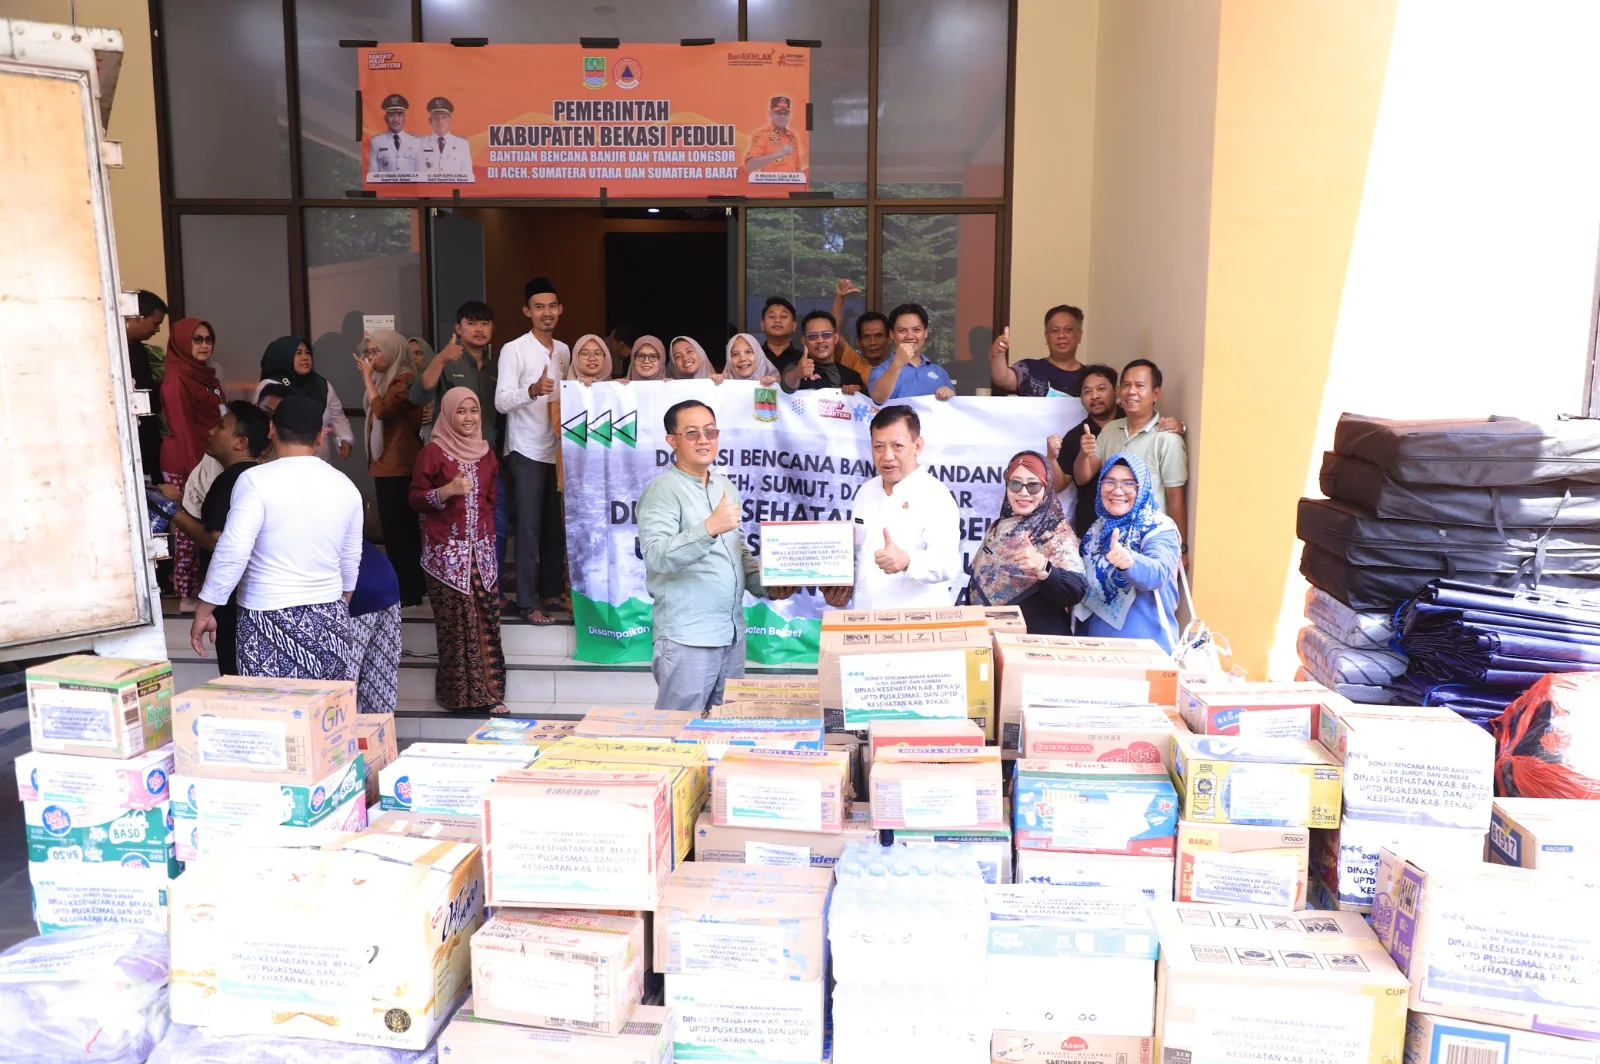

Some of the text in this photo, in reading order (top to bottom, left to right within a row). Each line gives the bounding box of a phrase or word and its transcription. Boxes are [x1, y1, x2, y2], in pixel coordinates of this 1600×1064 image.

[553, 100, 670, 121] PEMERINTAH
[488, 125, 735, 147] KABUPATEN BEKASI PEDULI
[489, 151, 735, 163] BANTUAN BENCANA BANJIR DAN TANAH LONGSOR
[488, 167, 738, 179] DI ACEH, SUMATERA UTARA DAN SUMATERA BARAT
[741, 449, 835, 475] BENCANA
[760, 475, 834, 502] SUMUT,
[588, 624, 650, 640] Disampaikan
[175, 702, 192, 714] NEW
[321, 704, 348, 732] Giv
[1216, 714, 1240, 725] REGA
[1394, 762, 1426, 770] BENCANA
[1353, 773, 1459, 789] DINAS KESEHATAN KAB.
[1359, 784, 1382, 792] UPTD
[1384, 786, 1440, 797] PUSKESMAS,
[1443, 790, 1463, 798] DAN
[1367, 794, 1477, 810] KESEHATAN KAB. BEKASI
[114, 828, 140, 839] BASO
[1188, 838, 1212, 846] BARU!
[1347, 866, 1375, 876] DINAS
[1481, 943, 1541, 958] KESEHATAN
[1483, 953, 1547, 971] PUSKESMAS,
[1463, 963, 1523, 979] KESEHATAN
[1385, 988, 1406, 996] CUP
[682, 1015, 708, 1023] DINAS
[712, 1026, 765, 1034] PUSKESMAS,
[767, 1027, 786, 1035] DAN
[787, 1028, 810, 1036] UPTD
